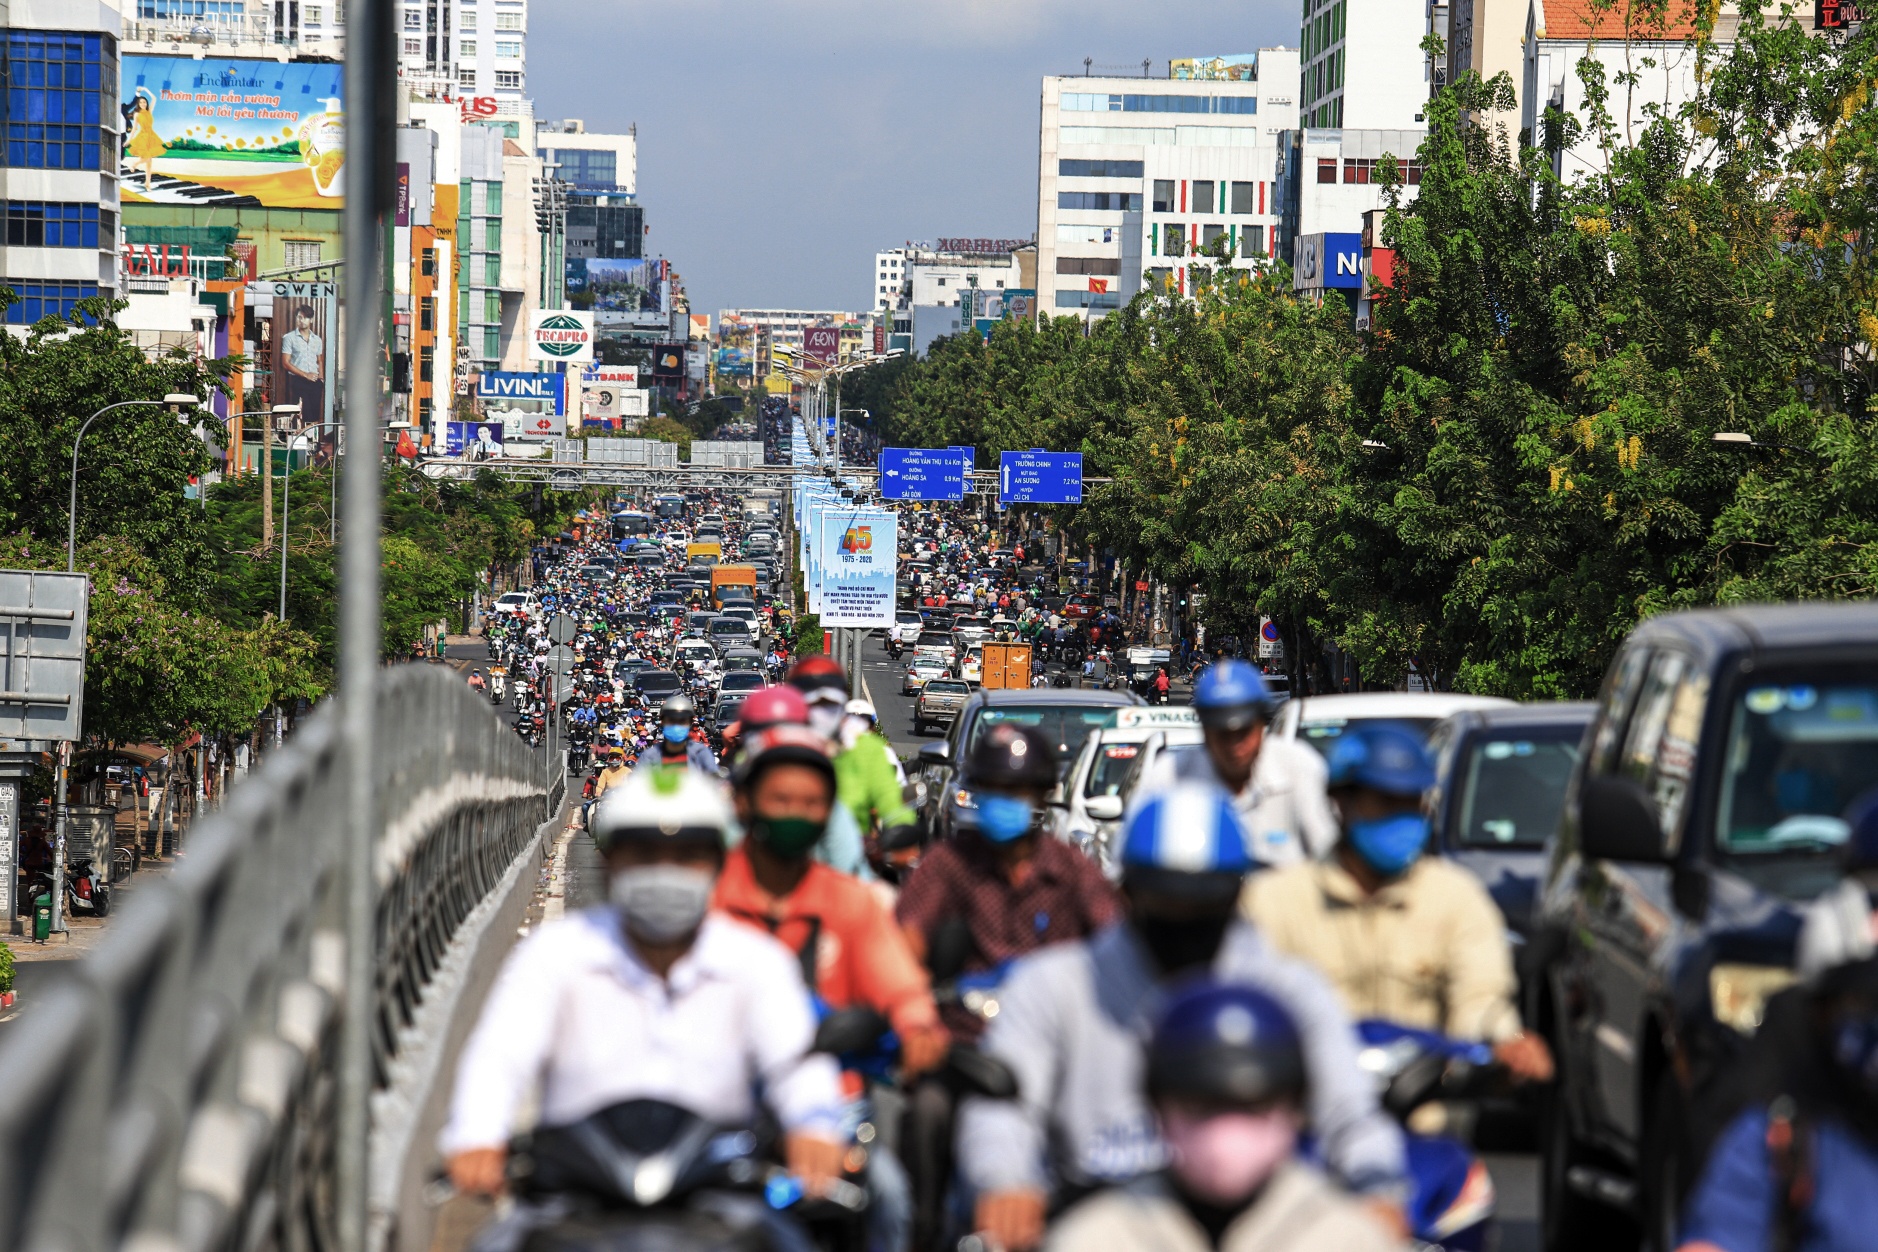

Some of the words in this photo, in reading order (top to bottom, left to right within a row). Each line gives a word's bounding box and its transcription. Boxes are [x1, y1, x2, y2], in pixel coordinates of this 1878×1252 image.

[398, 186, 407, 214] TPBank
[1337, 252, 1363, 275] N
[275, 284, 334, 296] OWEN
[535, 330, 588, 342] TECAPRO
[481, 374, 541, 396] LIVINI
[902, 457, 920, 465] HOÀNG
[921, 457, 931, 465] VĂN
[932, 458, 942, 467] THỤ
[1015, 459, 1035, 468] TRƯỜNG
[902, 490, 910, 498] SÀI
[911, 490, 922, 498] GÒN
[842, 525, 872, 554] 45
[842, 555, 855, 563] 1975
[859, 555, 873, 563] 2020
